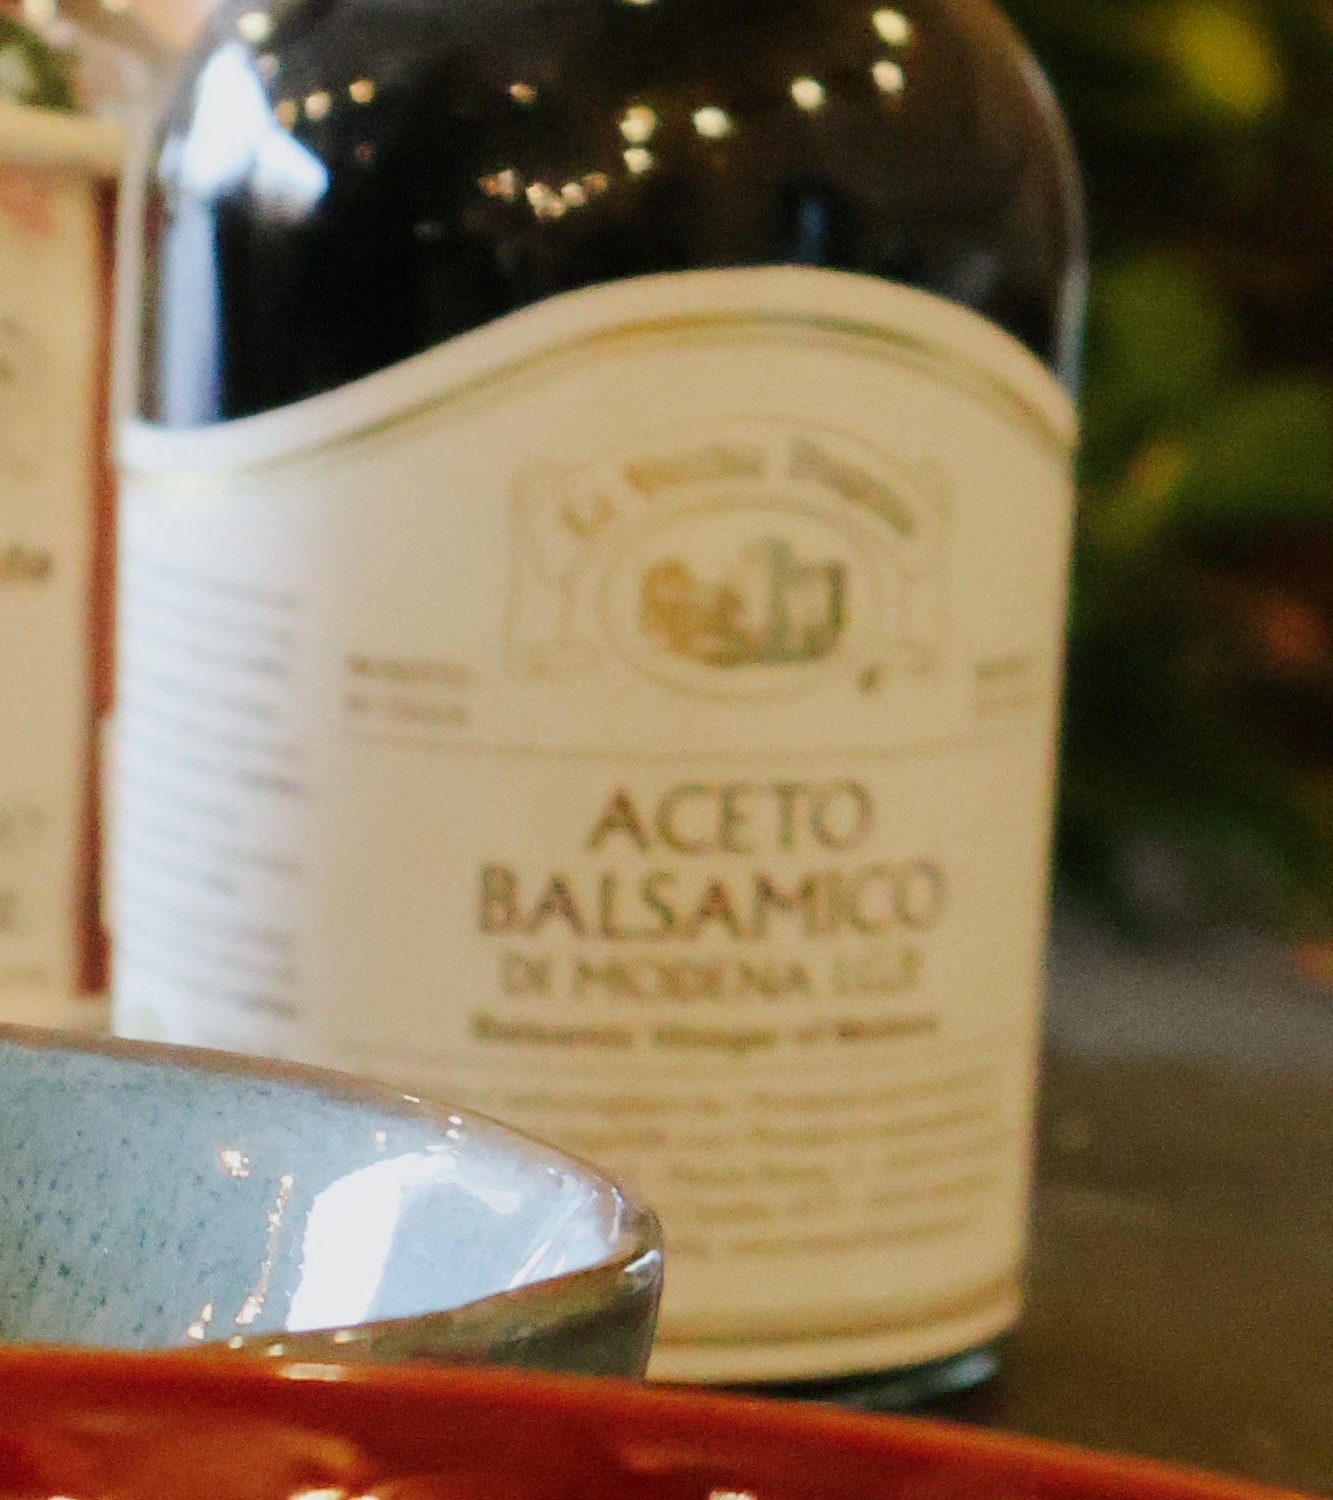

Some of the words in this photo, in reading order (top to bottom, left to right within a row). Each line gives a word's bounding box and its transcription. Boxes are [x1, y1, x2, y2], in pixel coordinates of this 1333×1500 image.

[584, 780, 877, 854] ACETO
[477, 858, 948, 940] BALSAMICO
[572, 956, 813, 1001] MODENA
